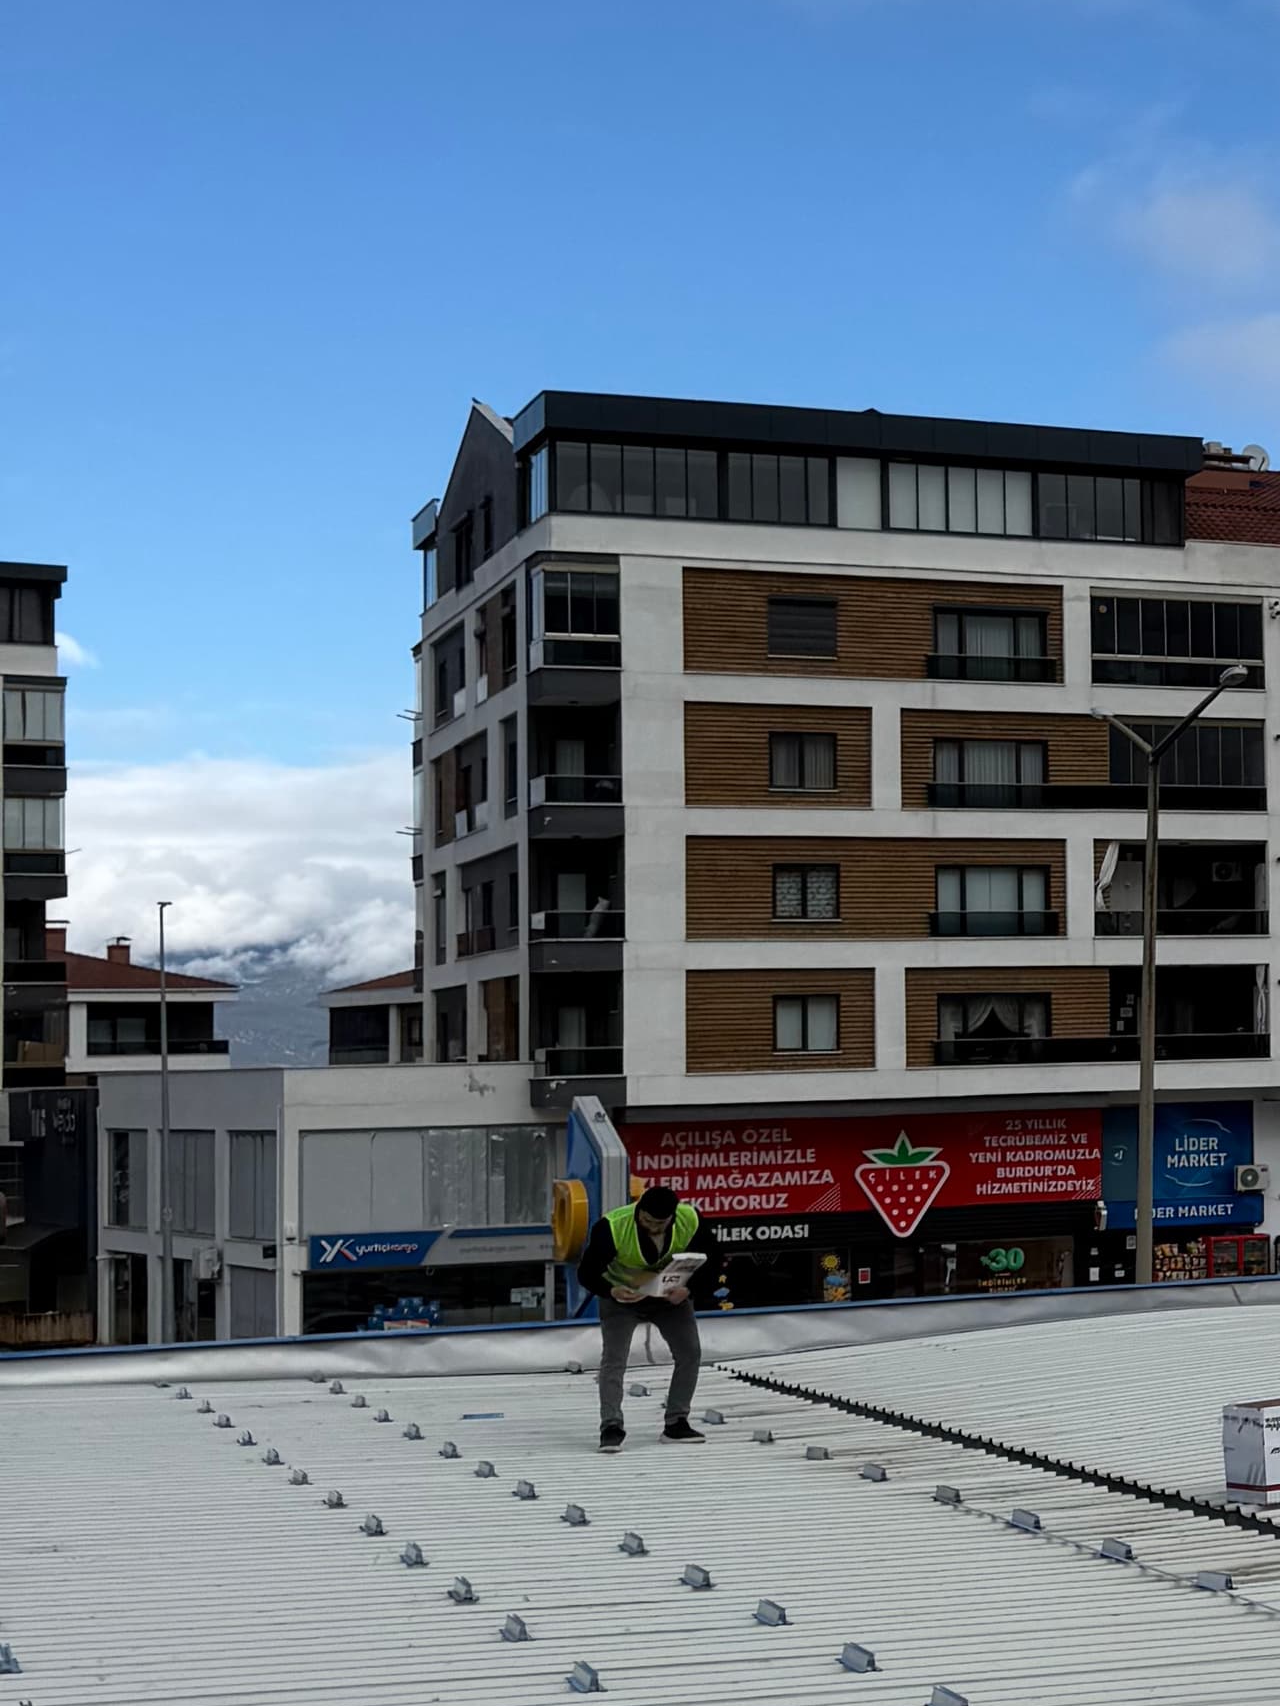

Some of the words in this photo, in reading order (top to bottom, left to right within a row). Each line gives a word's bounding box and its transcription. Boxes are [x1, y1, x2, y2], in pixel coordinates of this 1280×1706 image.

[1005, 1120, 1022, 1131] 25
[660, 1129, 736, 1150] AÇILIŞA
[742, 1126, 792, 1144] ÖZEL
[984, 1132, 1068, 1148] TECRÜBEMİZ
[1070, 1133, 1088, 1145] VE
[1174, 1134, 1218, 1152] LİDER
[636, 1146, 816, 1170] İNDİRİMLERİMİZLE
[969, 1149, 1002, 1163] YENİ
[1006, 1148, 1101, 1163] KADROMUZLA
[1167, 1153, 1228, 1169] MARKET
[696, 1169, 834, 1190] MAĞAZAMIZA
[868, 1169, 937, 1184] ÇİLEK
[996, 1165, 1076, 1179] BURDUR'DA
[976, 1176, 1096, 1196] HİZMETİNİZDEYİZ
[1177, 1204, 1234, 1219] MARKET
[711, 1224, 754, 1242] İLEK
[755, 1224, 809, 1241] ODASI
